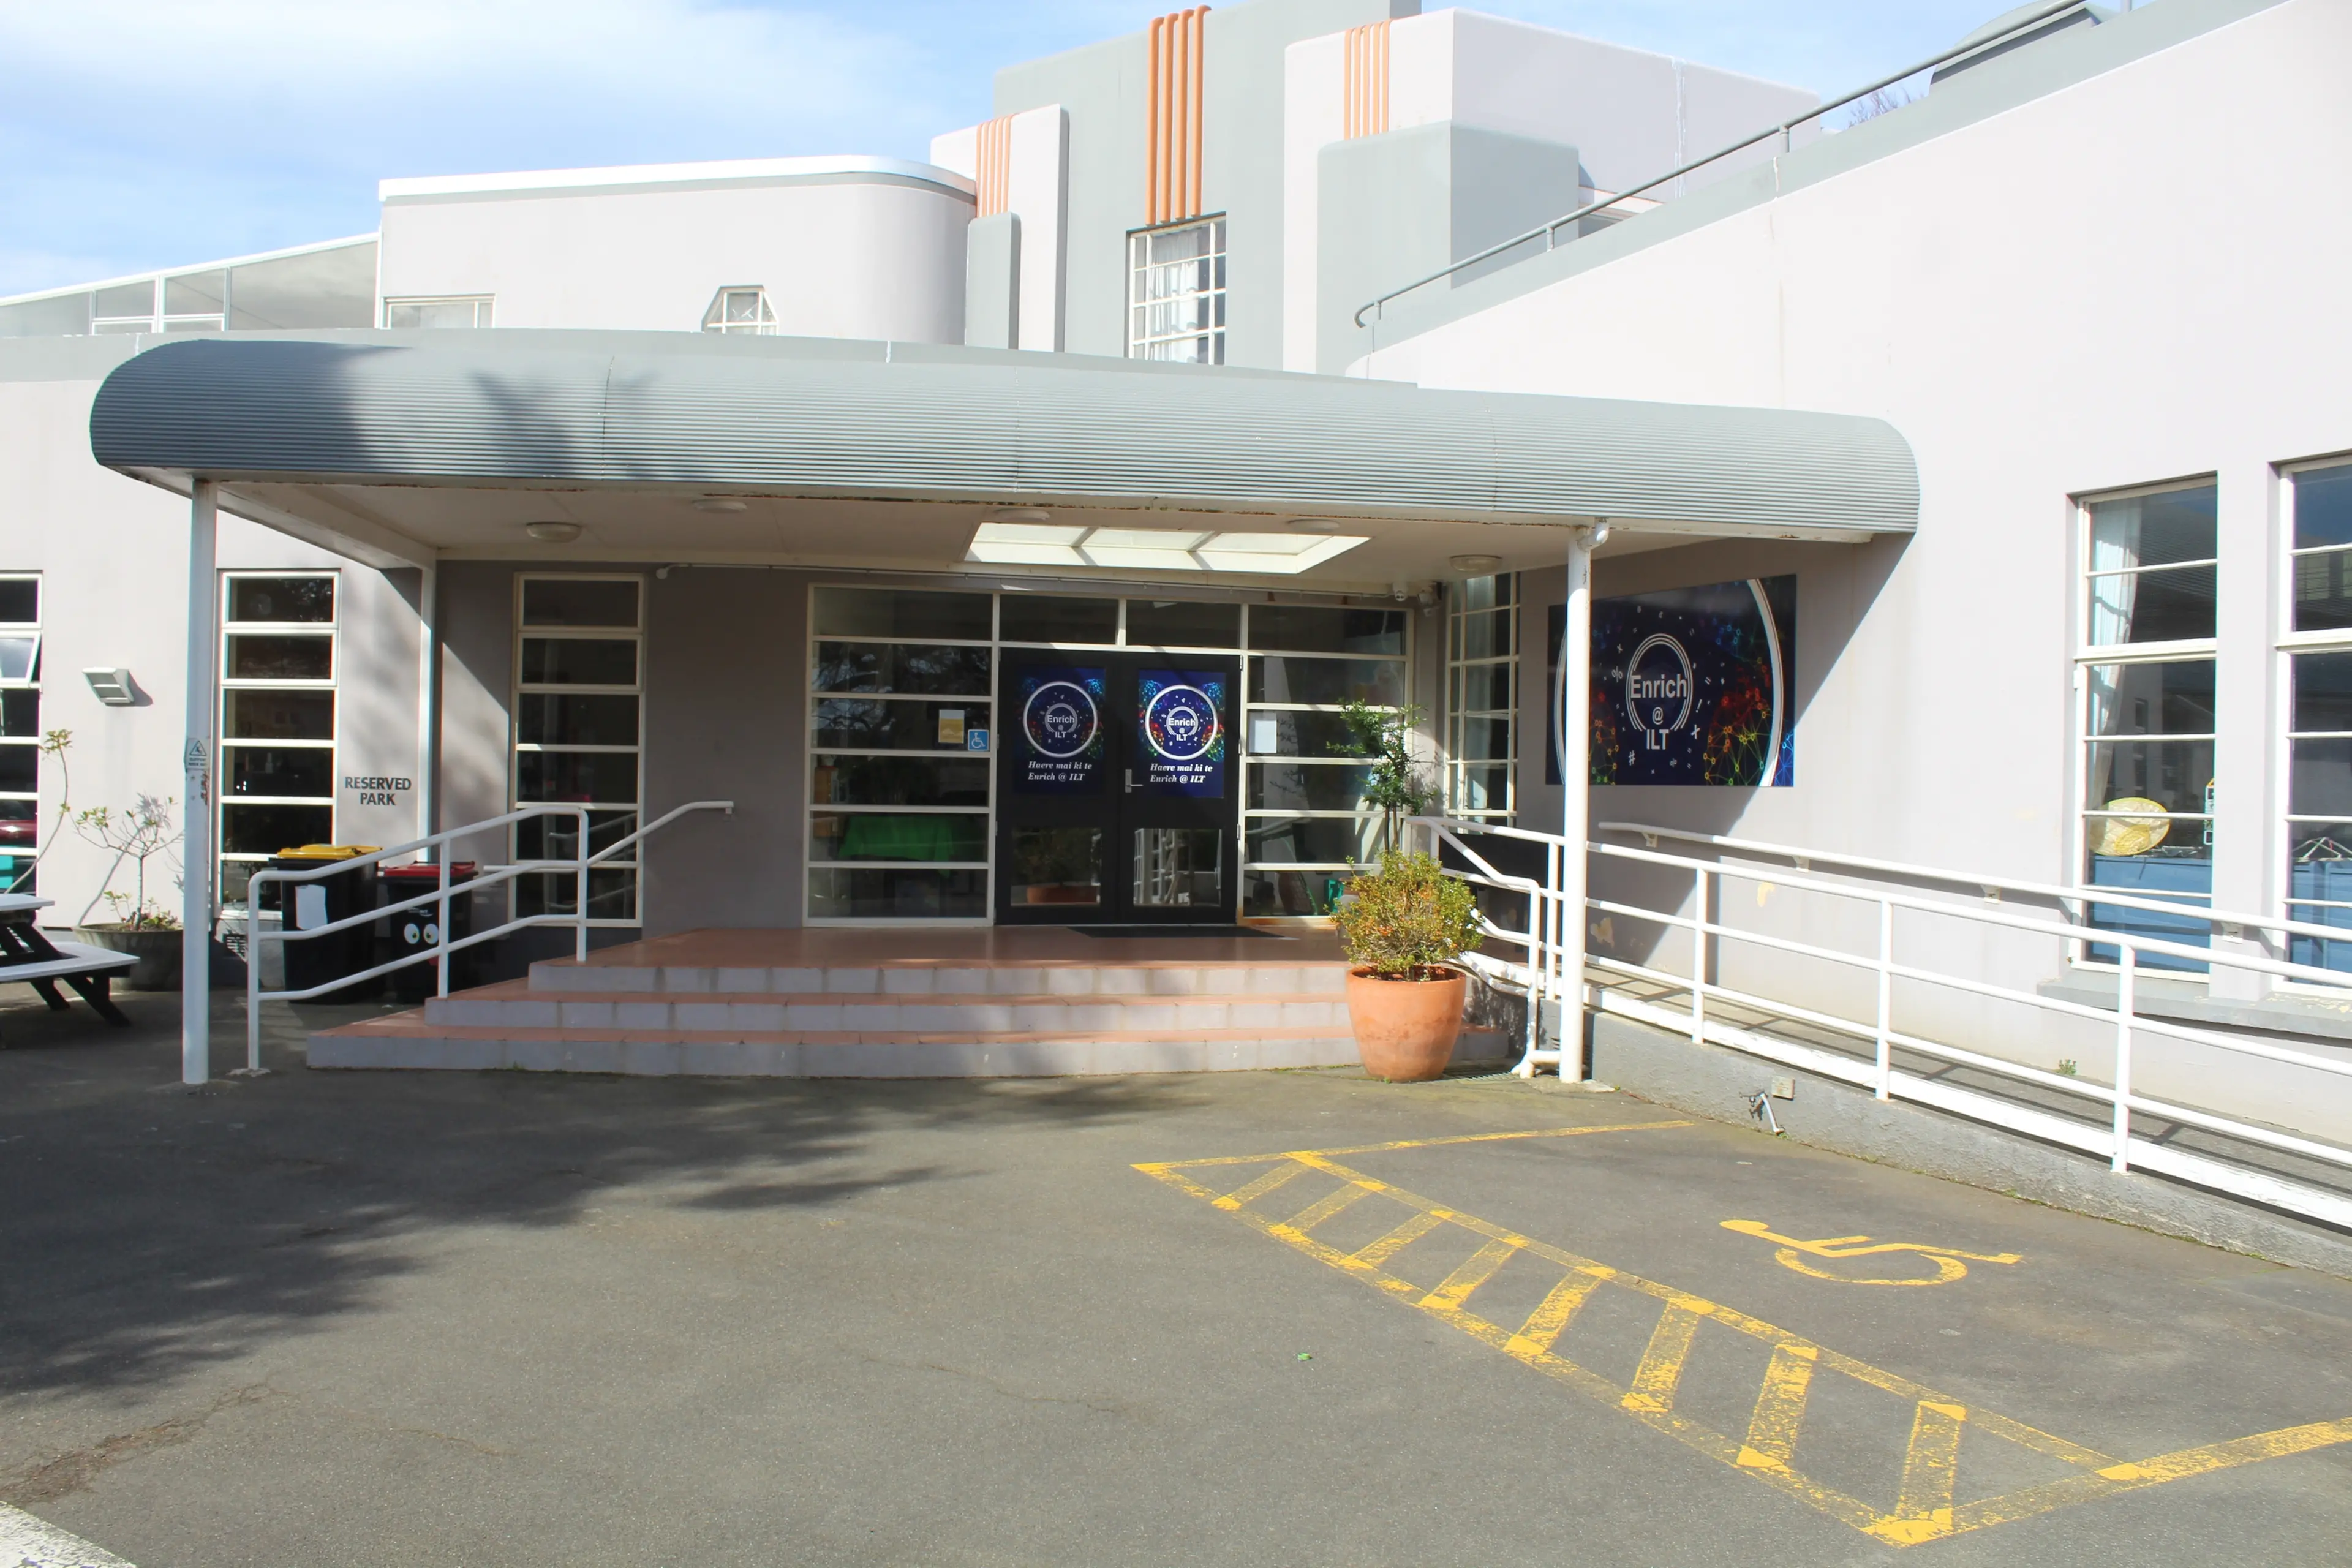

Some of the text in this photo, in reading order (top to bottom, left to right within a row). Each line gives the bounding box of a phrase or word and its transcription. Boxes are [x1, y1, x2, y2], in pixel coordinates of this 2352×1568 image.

[1630, 674, 1687, 698] Enrich
[1047, 715, 1075, 723] Enrich
[1169, 718, 1196, 726] Enrich
[1652, 707, 1664, 725] @
[1646, 729, 1669, 750] ILT
[344, 777, 412, 790] RESERVED
[1058, 772, 1067, 782] @
[1179, 775, 1188, 784] @
[360, 792, 396, 805] PARK
